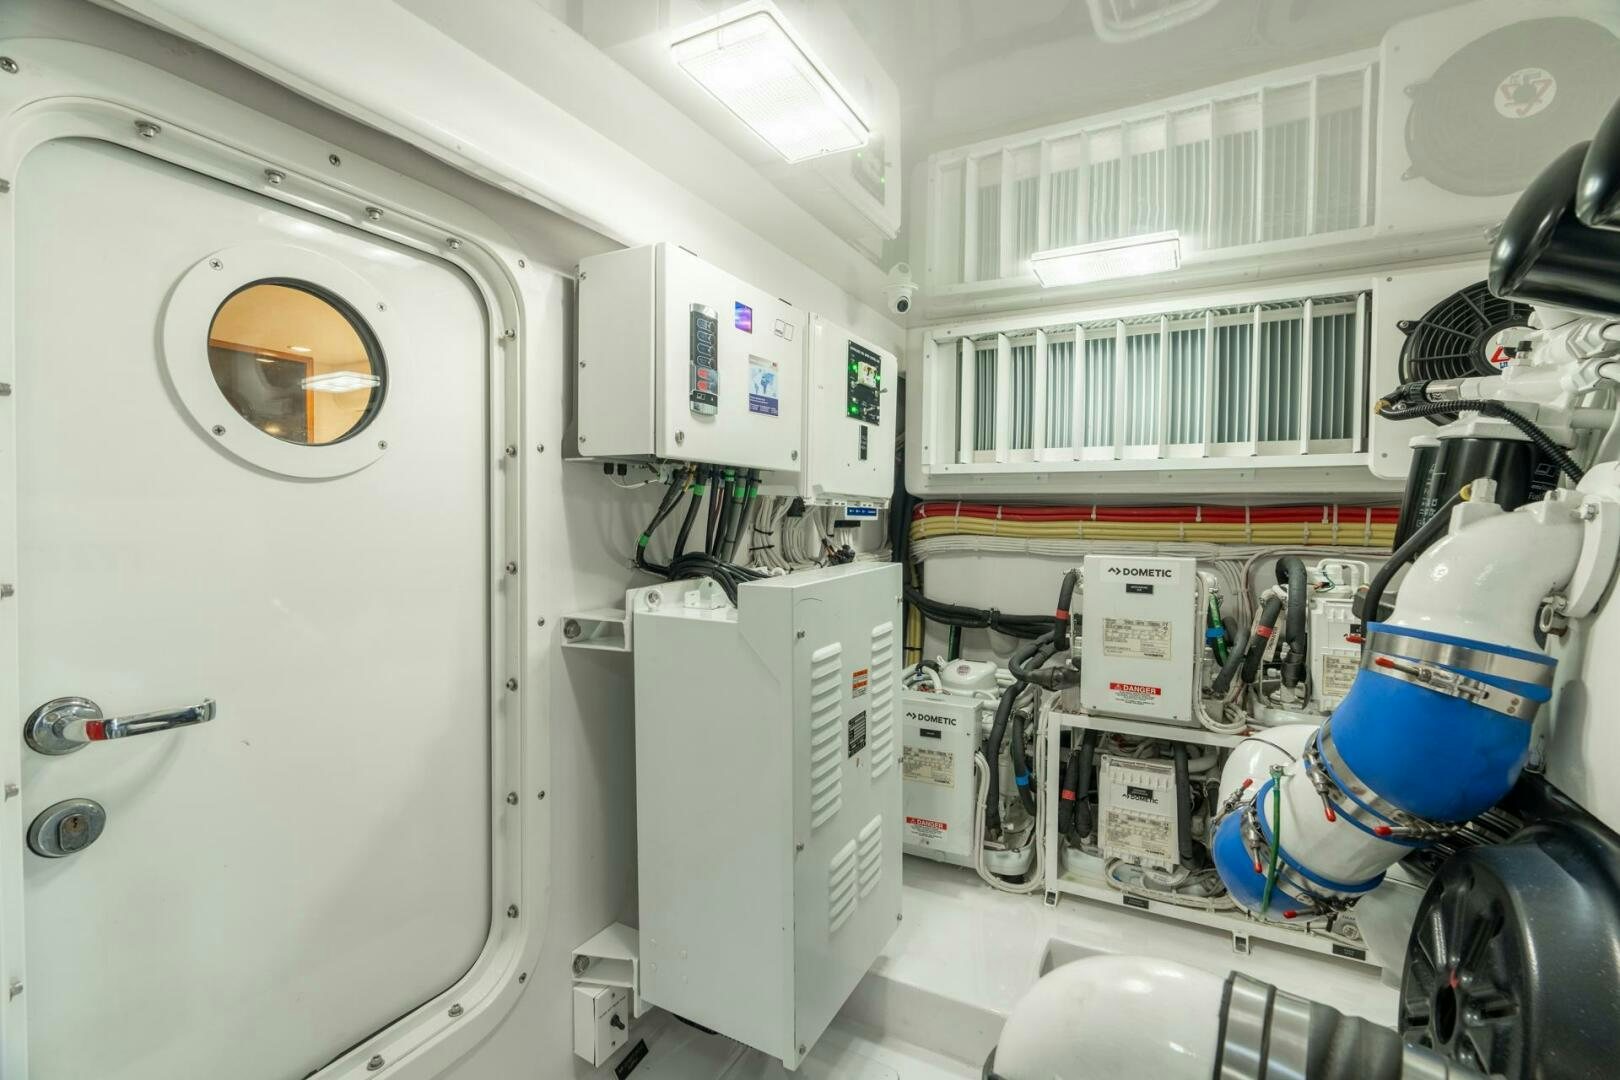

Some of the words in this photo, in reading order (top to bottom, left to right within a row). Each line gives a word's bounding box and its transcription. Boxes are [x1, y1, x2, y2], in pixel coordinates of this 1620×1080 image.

[1122, 567, 1172, 578] DOMETIC
[1123, 684, 1156, 695] DANGER
[917, 713, 957, 726] DOMETIC
[916, 819, 943, 830] DANGER
